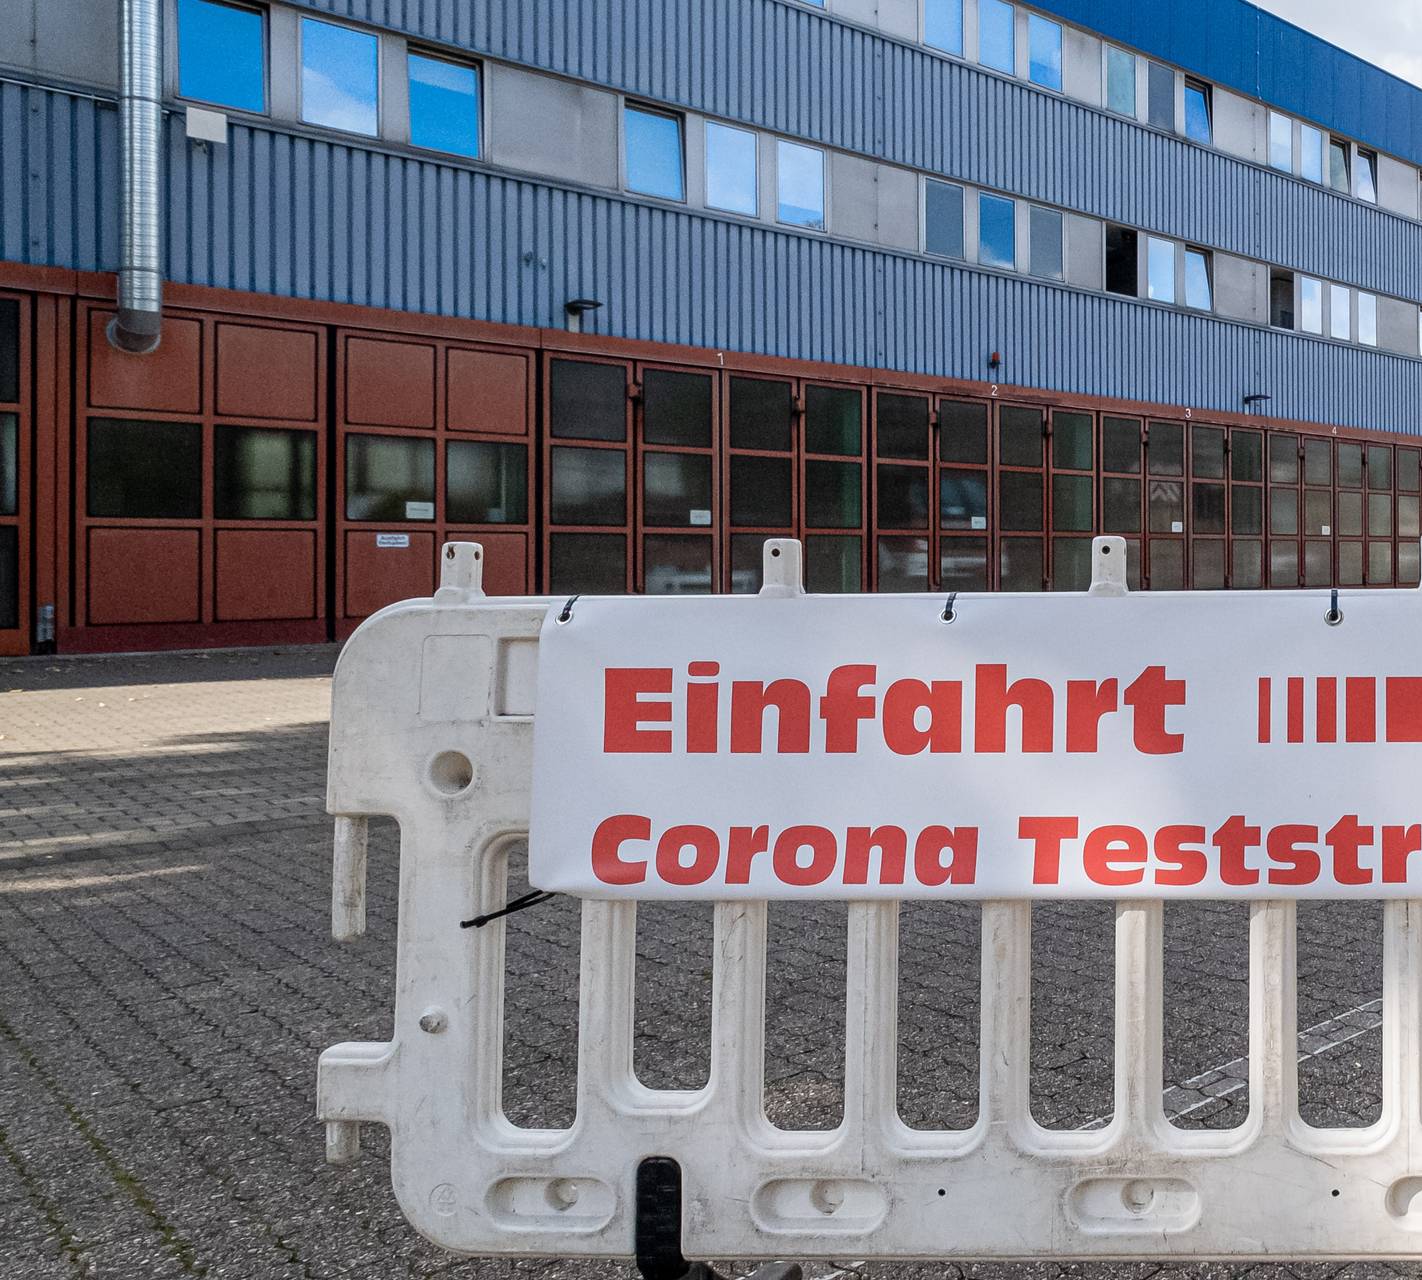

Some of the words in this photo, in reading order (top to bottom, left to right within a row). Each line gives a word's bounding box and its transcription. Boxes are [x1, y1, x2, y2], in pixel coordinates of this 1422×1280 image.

[716, 352, 724, 365] 1
[991, 384, 998, 396] 2
[1185, 408, 1192, 418] 3
[1331, 426, 1337, 435] 4
[603, 662, 1186, 756] Einfahrt
[591, 815, 979, 887] Corona
